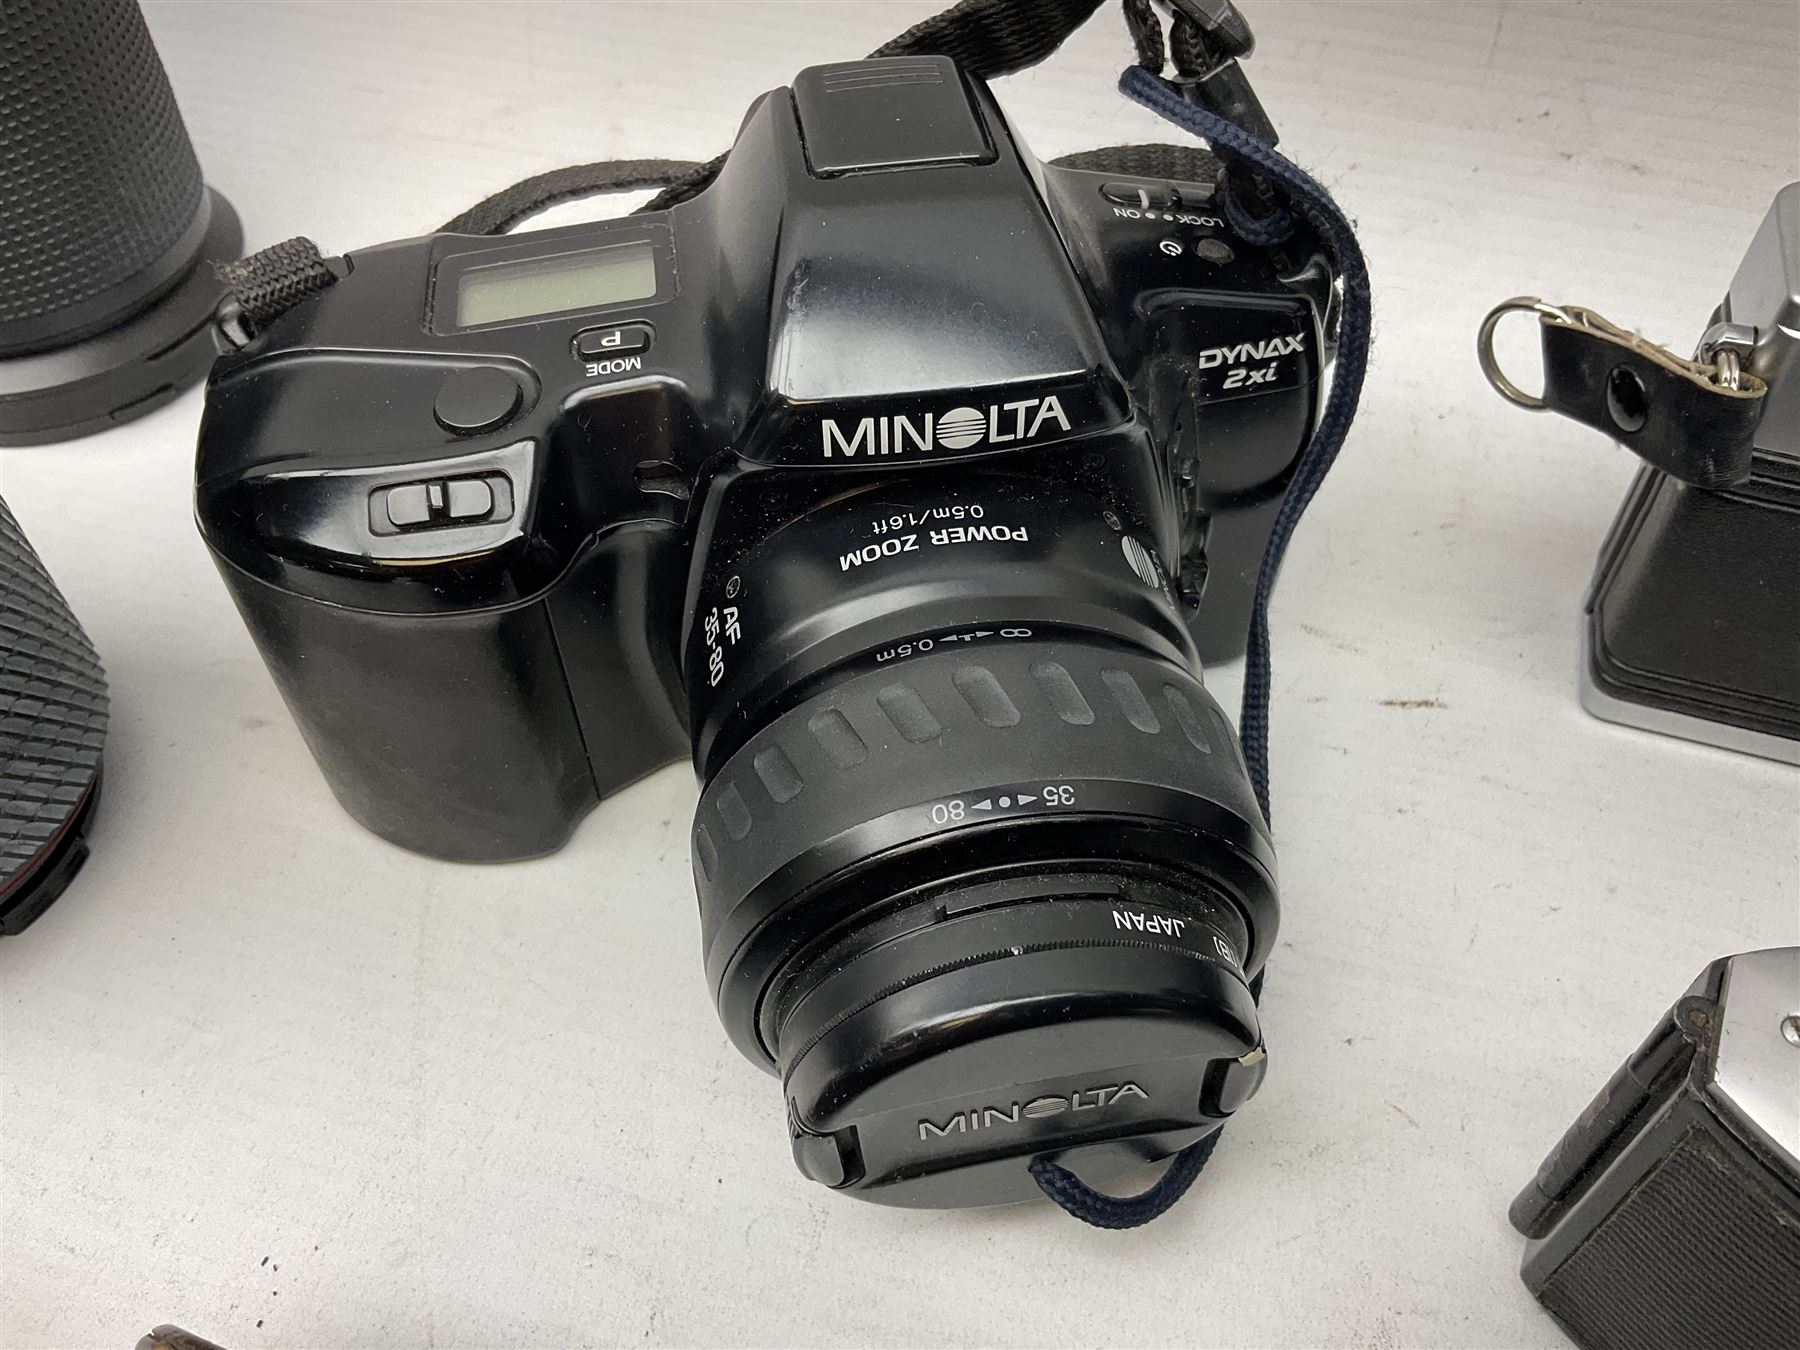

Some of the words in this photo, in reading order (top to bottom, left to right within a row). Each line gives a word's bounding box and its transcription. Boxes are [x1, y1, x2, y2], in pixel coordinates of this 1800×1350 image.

[1113, 207, 1140, 219] ON
[1175, 214, 1225, 228] LOCK
[601, 331, 621, 347] P
[1198, 333, 1305, 370] DYNAX
[585, 356, 642, 377] MODE
[1222, 362, 1279, 390] 2xi
[820, 395, 1071, 459] MINOLTA
[871, 504, 984, 535] 0.5m/1.6ft
[929, 525, 1029, 546] POWER
[839, 534, 920, 572] ZOOM
[723, 606, 741, 646] AF
[704, 606, 725, 687] 35-80
[876, 638, 934, 662] 0.5m
[1042, 785, 1075, 806] 35
[931, 799, 965, 825] 80
[1112, 909, 1185, 938] JAPAN
[918, 1081, 1150, 1141] MINOLTA
